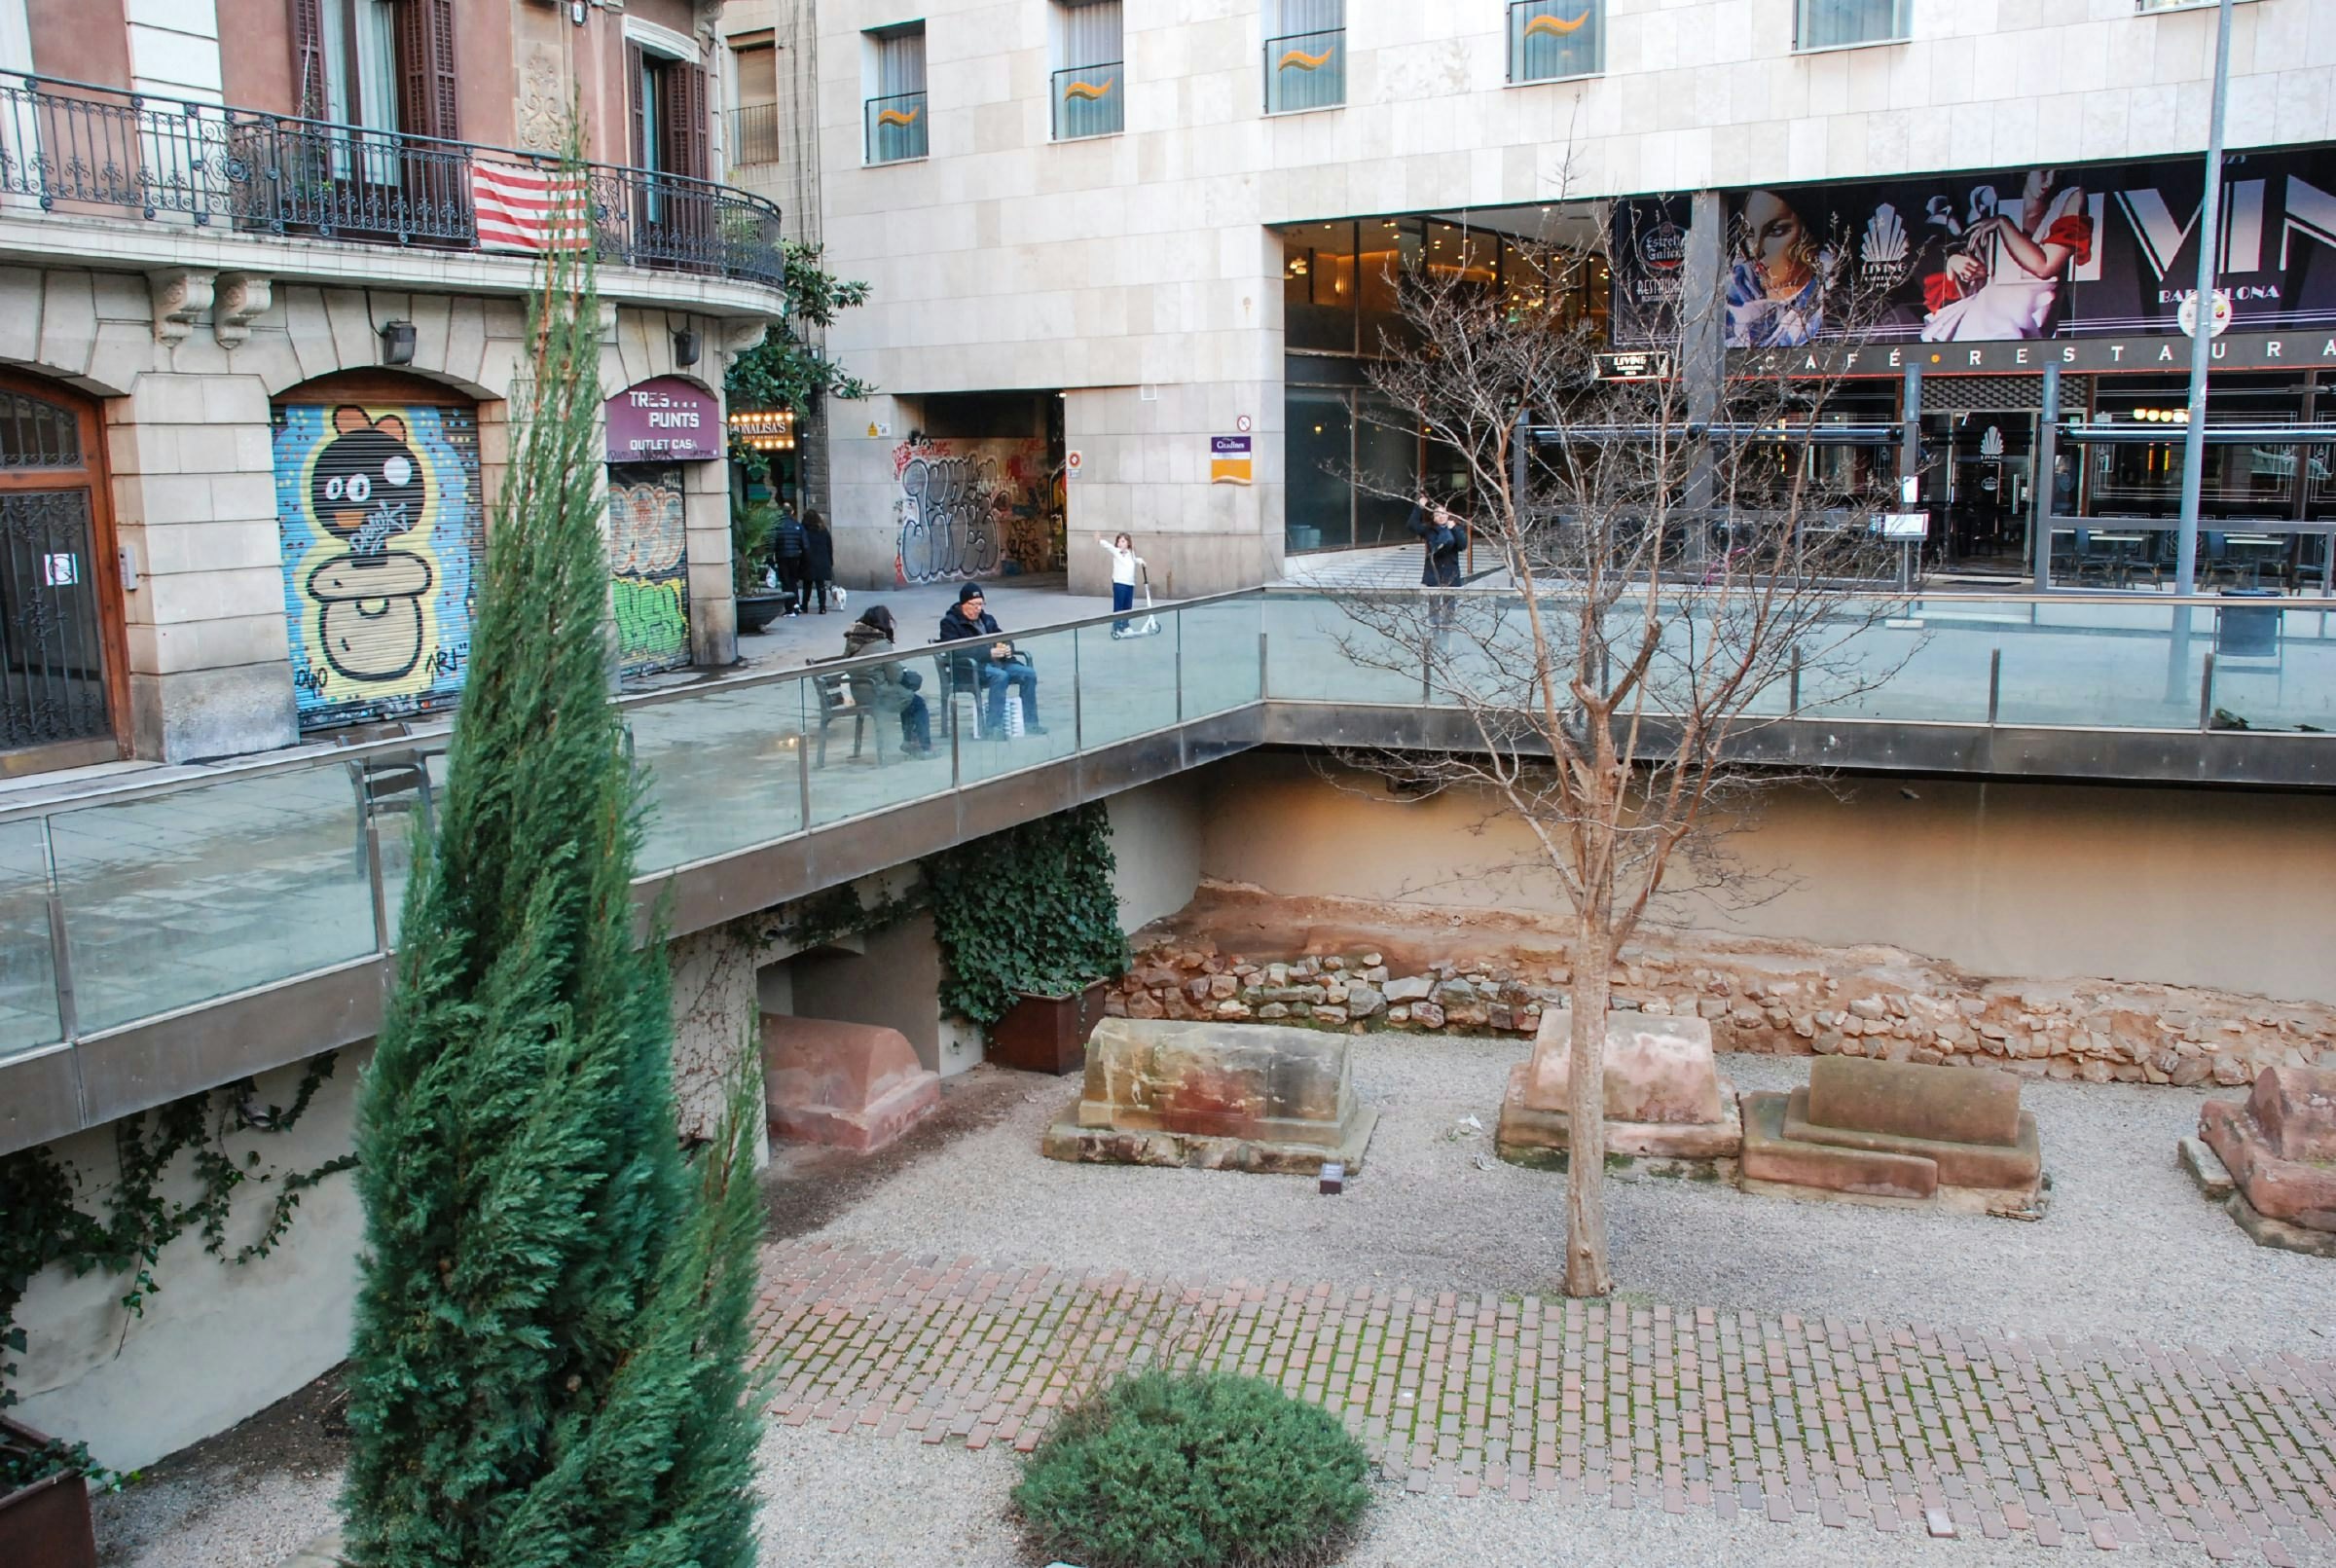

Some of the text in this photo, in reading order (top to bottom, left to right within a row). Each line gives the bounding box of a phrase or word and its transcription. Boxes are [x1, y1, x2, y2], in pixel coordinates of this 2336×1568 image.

[2158, 285, 2281, 304] BALONA
[1613, 355, 1647, 366] LIVING
[1765, 347, 1900, 370] CAFÉ
[649, 412, 700, 428] PUNTS
[630, 438, 698, 451] OUTLET CASA
